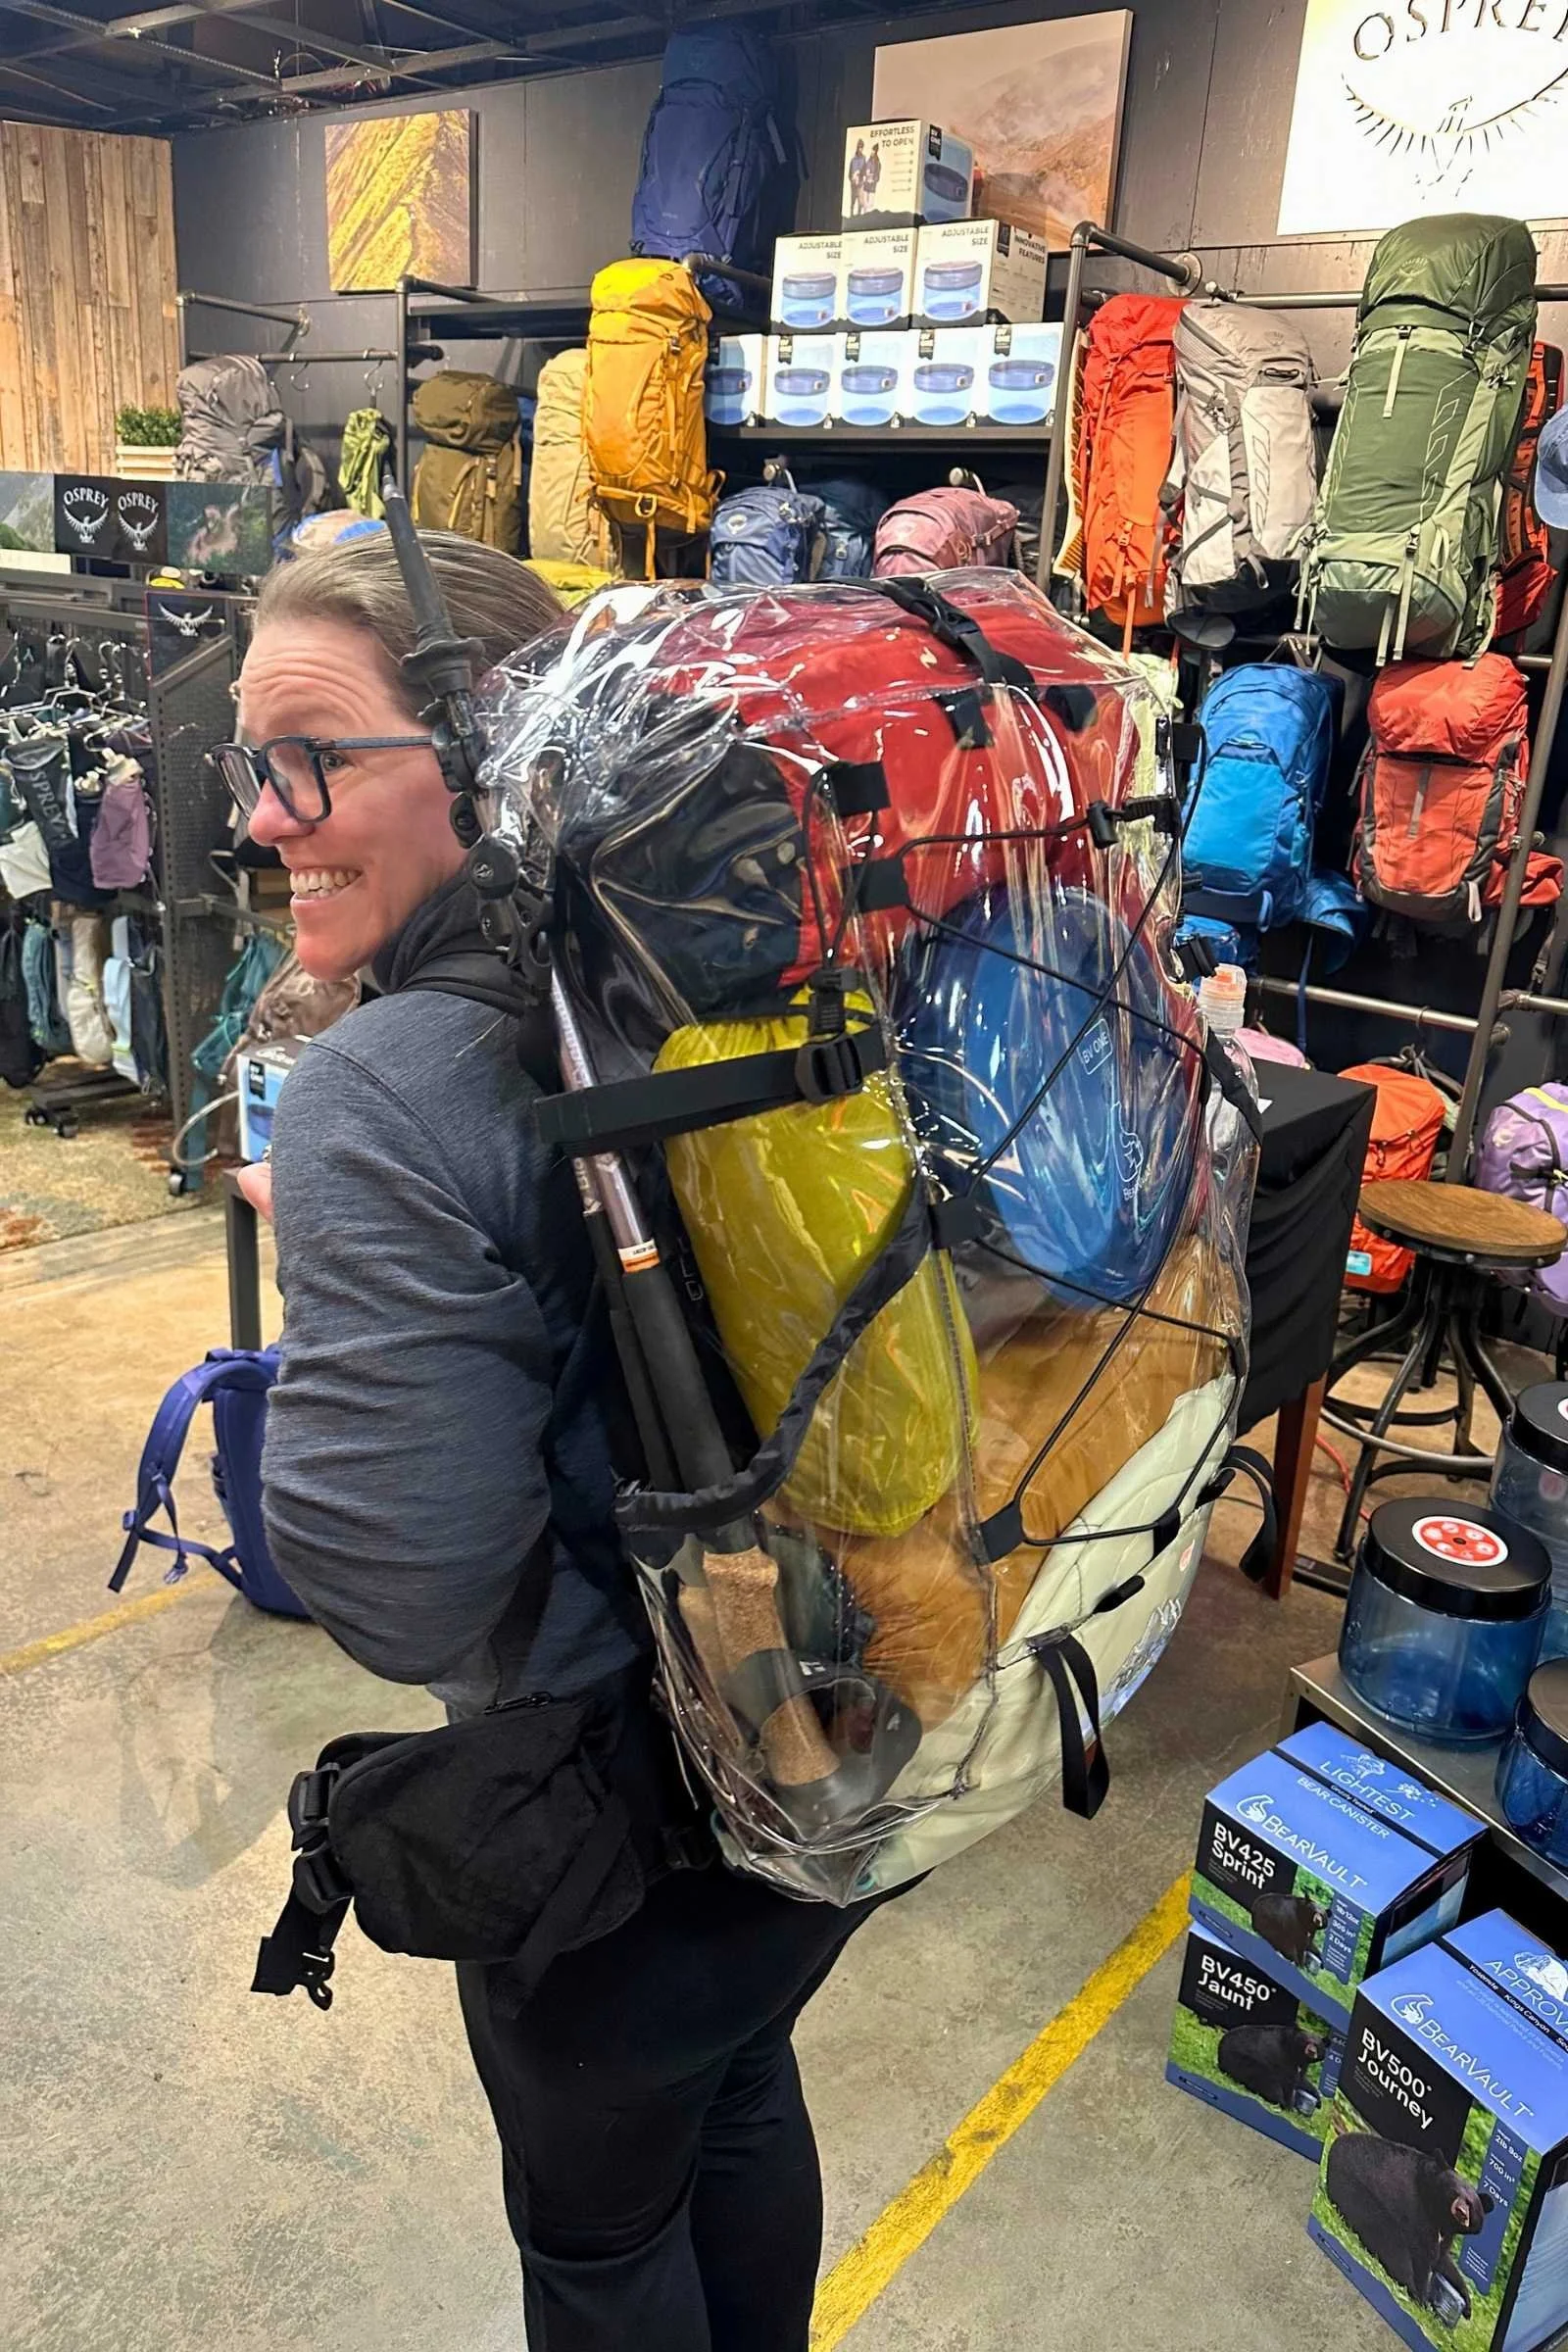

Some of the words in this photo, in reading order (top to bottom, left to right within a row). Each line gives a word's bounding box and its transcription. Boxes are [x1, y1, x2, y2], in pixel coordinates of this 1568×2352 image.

[1354, 0, 1568, 60] OSPRE
[869, 125, 915, 138] EFFORTLESS
[881, 139, 893, 148] TO
[893, 137, 914, 147] OPEN
[863, 234, 909, 245] ADJUSTABLE
[942, 226, 989, 237] ADJUSTABLE
[971, 237, 989, 246] SIZE
[798, 241, 843, 250] ADJUSTABLE
[826, 251, 842, 260] SIZE
[893, 245, 908, 254] SIZE
[63, 487, 110, 509] OSPREY
[118, 492, 159, 514] OSPREY
[1319, 1761, 1415, 1821] LIGHTEST
[1297, 1776, 1328, 1800] BEAR
[1329, 1796, 1391, 1839] CANISTER
[1214, 1821, 1276, 1878] BV425
[1211, 1838, 1266, 1890] Sprint
[1198, 1972, 1254, 2012] Jaunt
[1469, 1964, 1499, 1991] Yosemite
[1504, 1993, 1524, 2013] Kings
[1523, 2010, 1550, 2034] Canyon
[1357, 2048, 1434, 2131] Journey
[1489, 2158, 1503, 2177] 700
[1488, 2183, 1509, 2207] Days
